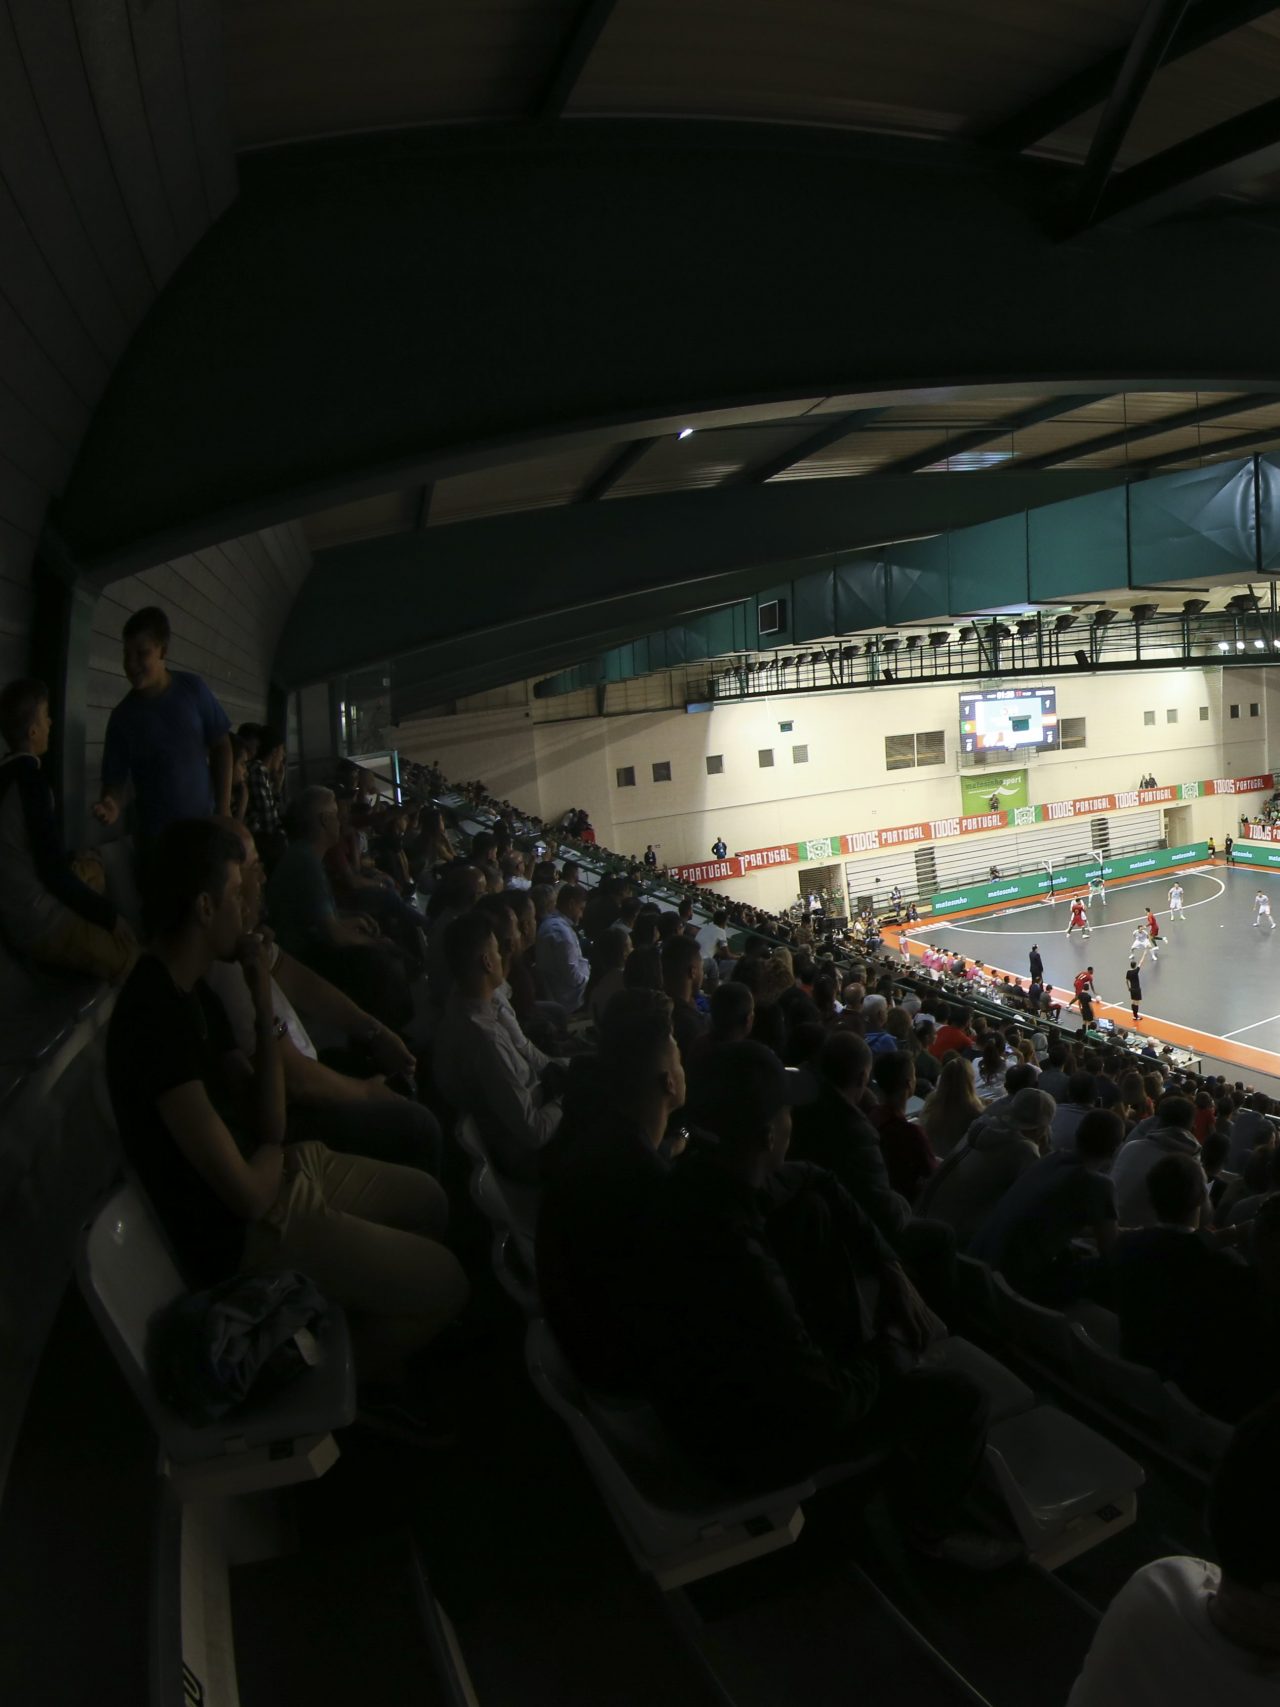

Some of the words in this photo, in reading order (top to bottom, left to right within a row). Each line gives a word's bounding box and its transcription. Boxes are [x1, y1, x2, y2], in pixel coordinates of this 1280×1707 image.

[1213, 779, 1235, 794] TODOS
[1236, 778, 1265, 791] PORTUGAL
[1047, 801, 1074, 820] TODOS
[1075, 797, 1111, 812] PORTUGAL
[1114, 791, 1139, 809] TODOS
[1140, 788, 1172, 803] PORTUGAL
[846, 830, 879, 852] TODOS
[882, 826, 925, 844] PORTUGAL
[929, 818, 961, 839] TODOS
[962, 813, 1002, 831] PORTUGAL
[745, 848, 791, 867] PORTUGAL
[683, 862, 733, 881] PORTUGAL
